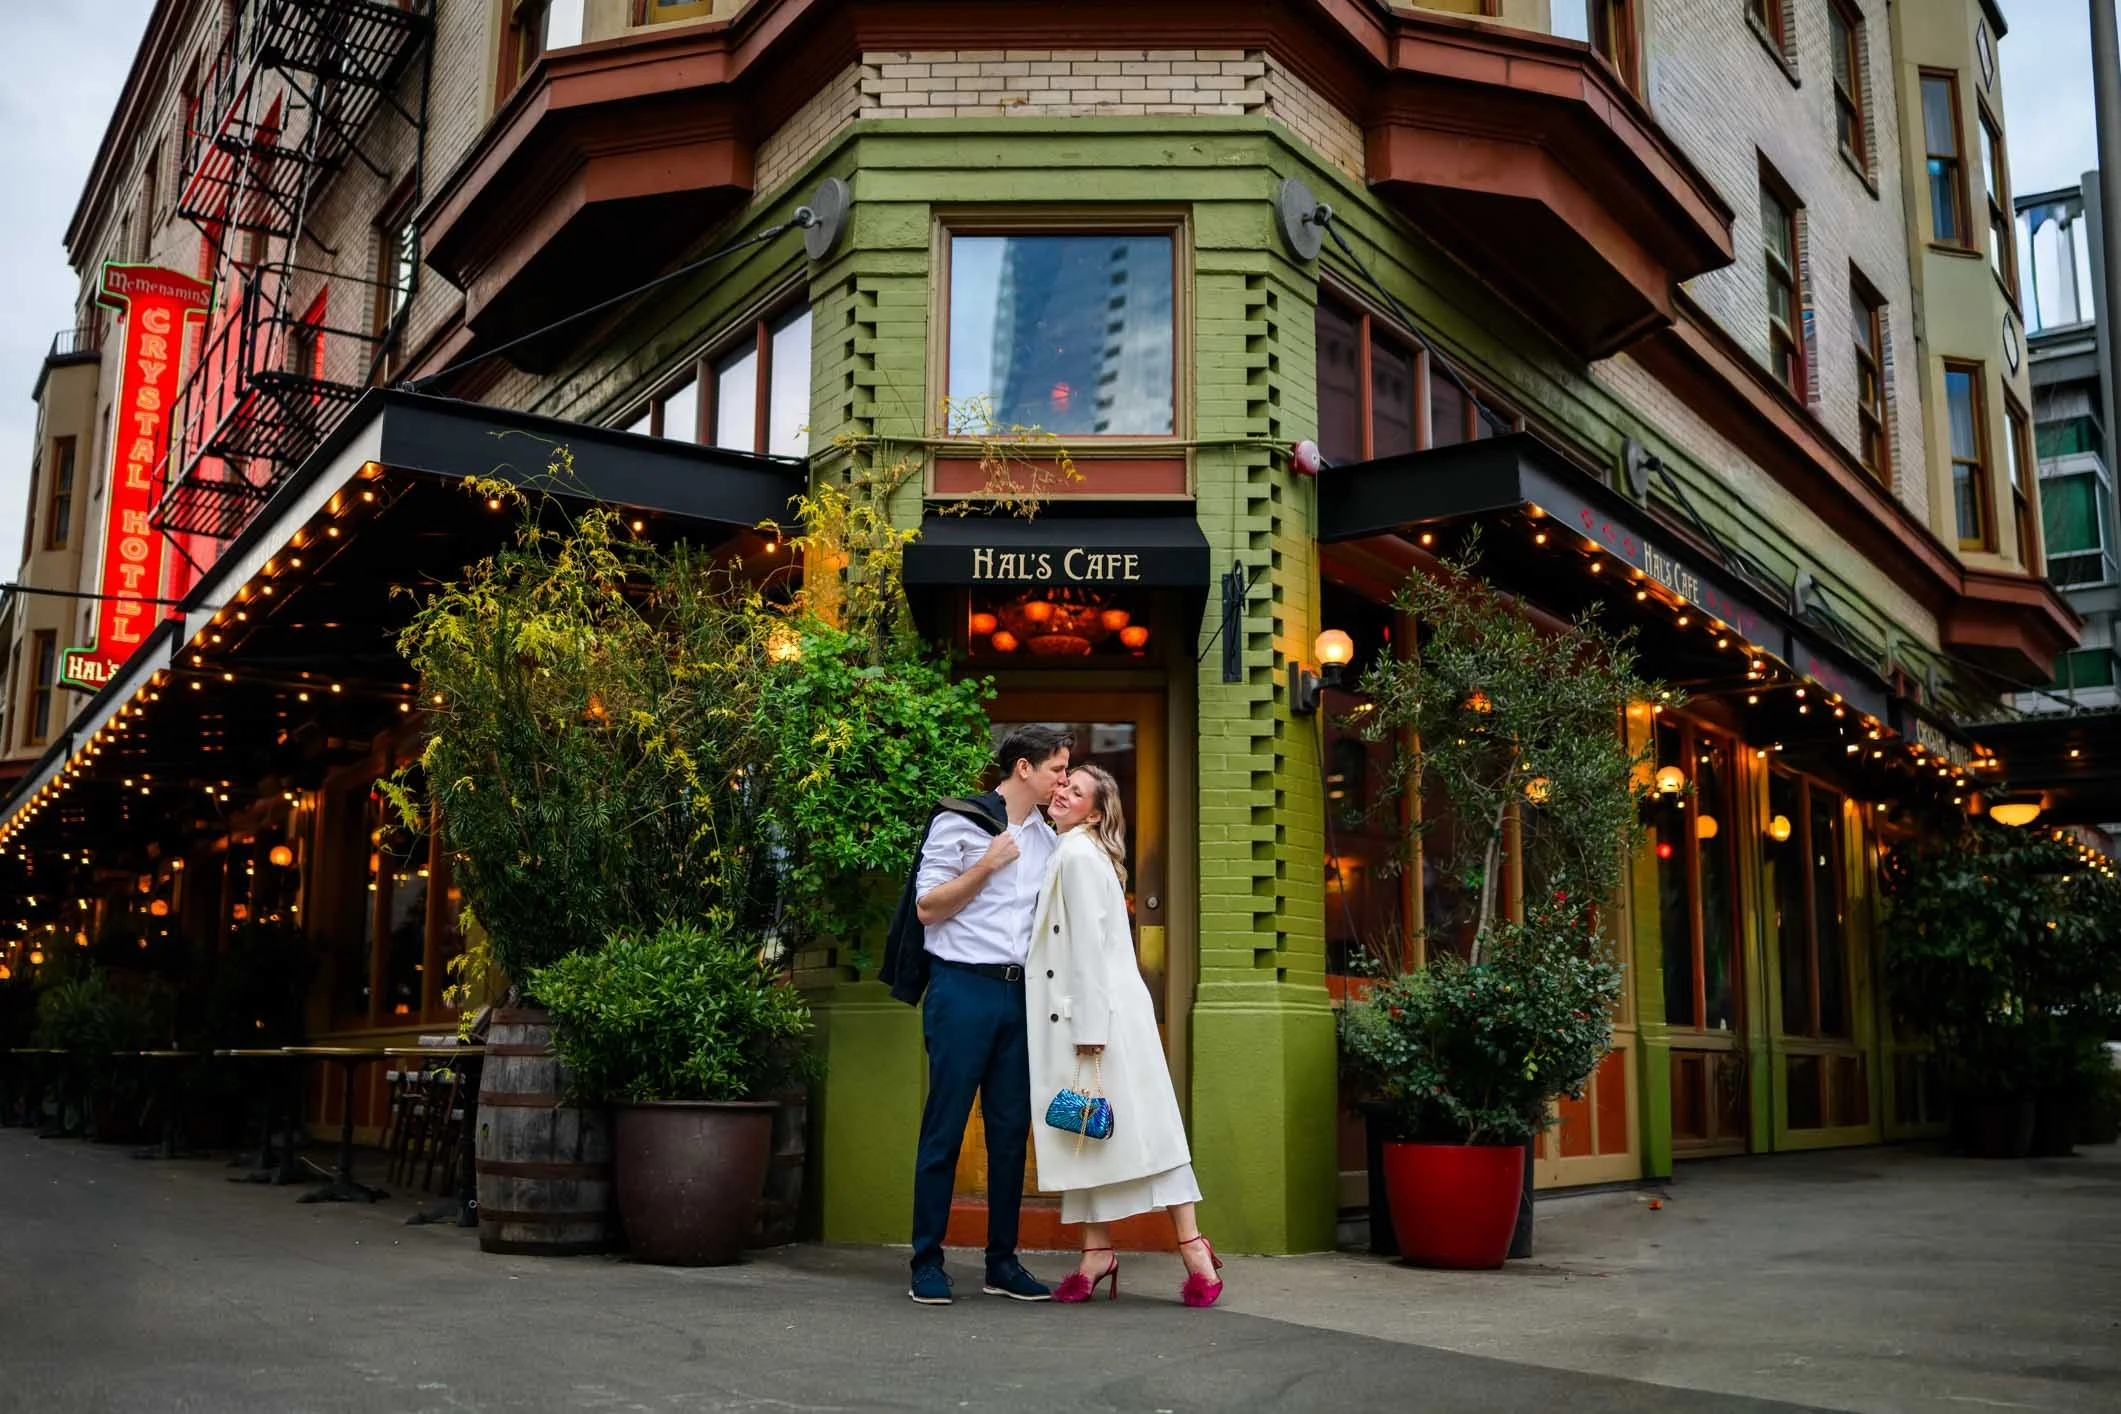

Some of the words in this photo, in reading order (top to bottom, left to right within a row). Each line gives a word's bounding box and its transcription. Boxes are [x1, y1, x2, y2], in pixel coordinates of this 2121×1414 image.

[125, 307, 171, 489] CRYSTAL
[111, 508, 150, 644] HOTEL
[972, 547, 1053, 581] HAL'S
[1063, 547, 1142, 581] CAFE
[1674, 562, 1700, 604] CAFE
